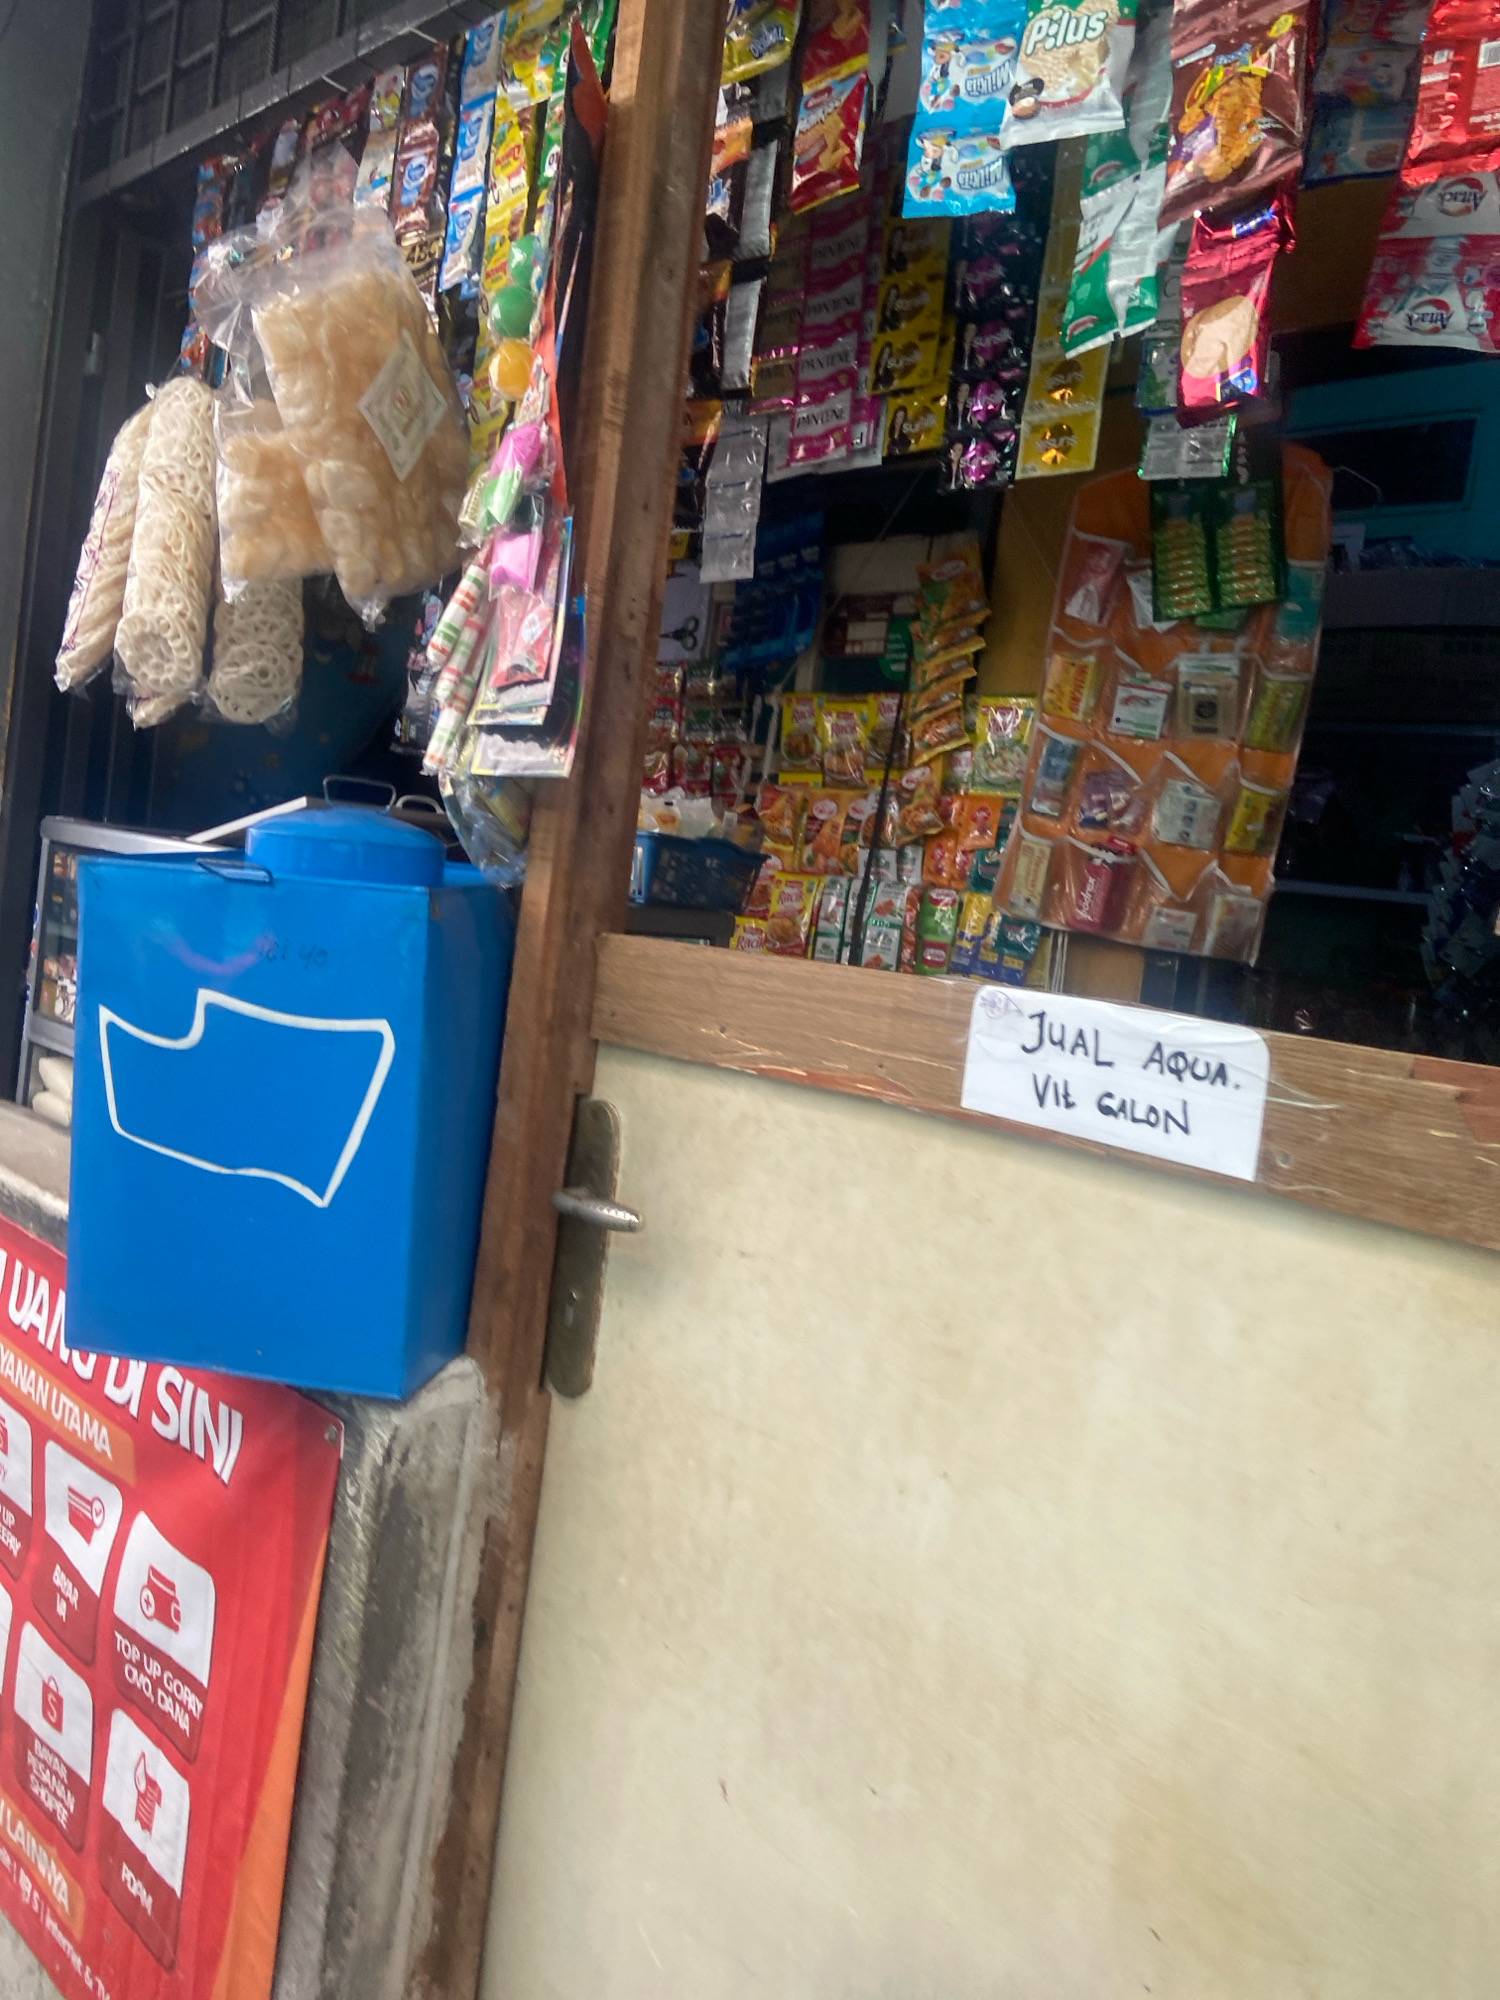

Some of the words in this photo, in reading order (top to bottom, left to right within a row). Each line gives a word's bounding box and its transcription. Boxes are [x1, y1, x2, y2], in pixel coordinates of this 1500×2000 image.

[1024, 8, 1109, 56] Pilus
[1021, 1010, 1115, 1069] JUAL
[1097, 1092, 1191, 1136] GALON
[51, 1386, 114, 1462] UTAMA
[151, 1366, 244, 1486] SINI
[2, 1506, 16, 1529] UP
[52, 1563, 80, 1611] BAYAR
[115, 1630, 141, 1664] TOP
[143, 1653, 162, 1680] UP
[163, 1670, 204, 1721] GOPAY
[157, 1688, 190, 1738] DANA
[121, 1862, 154, 1917] PDAM
